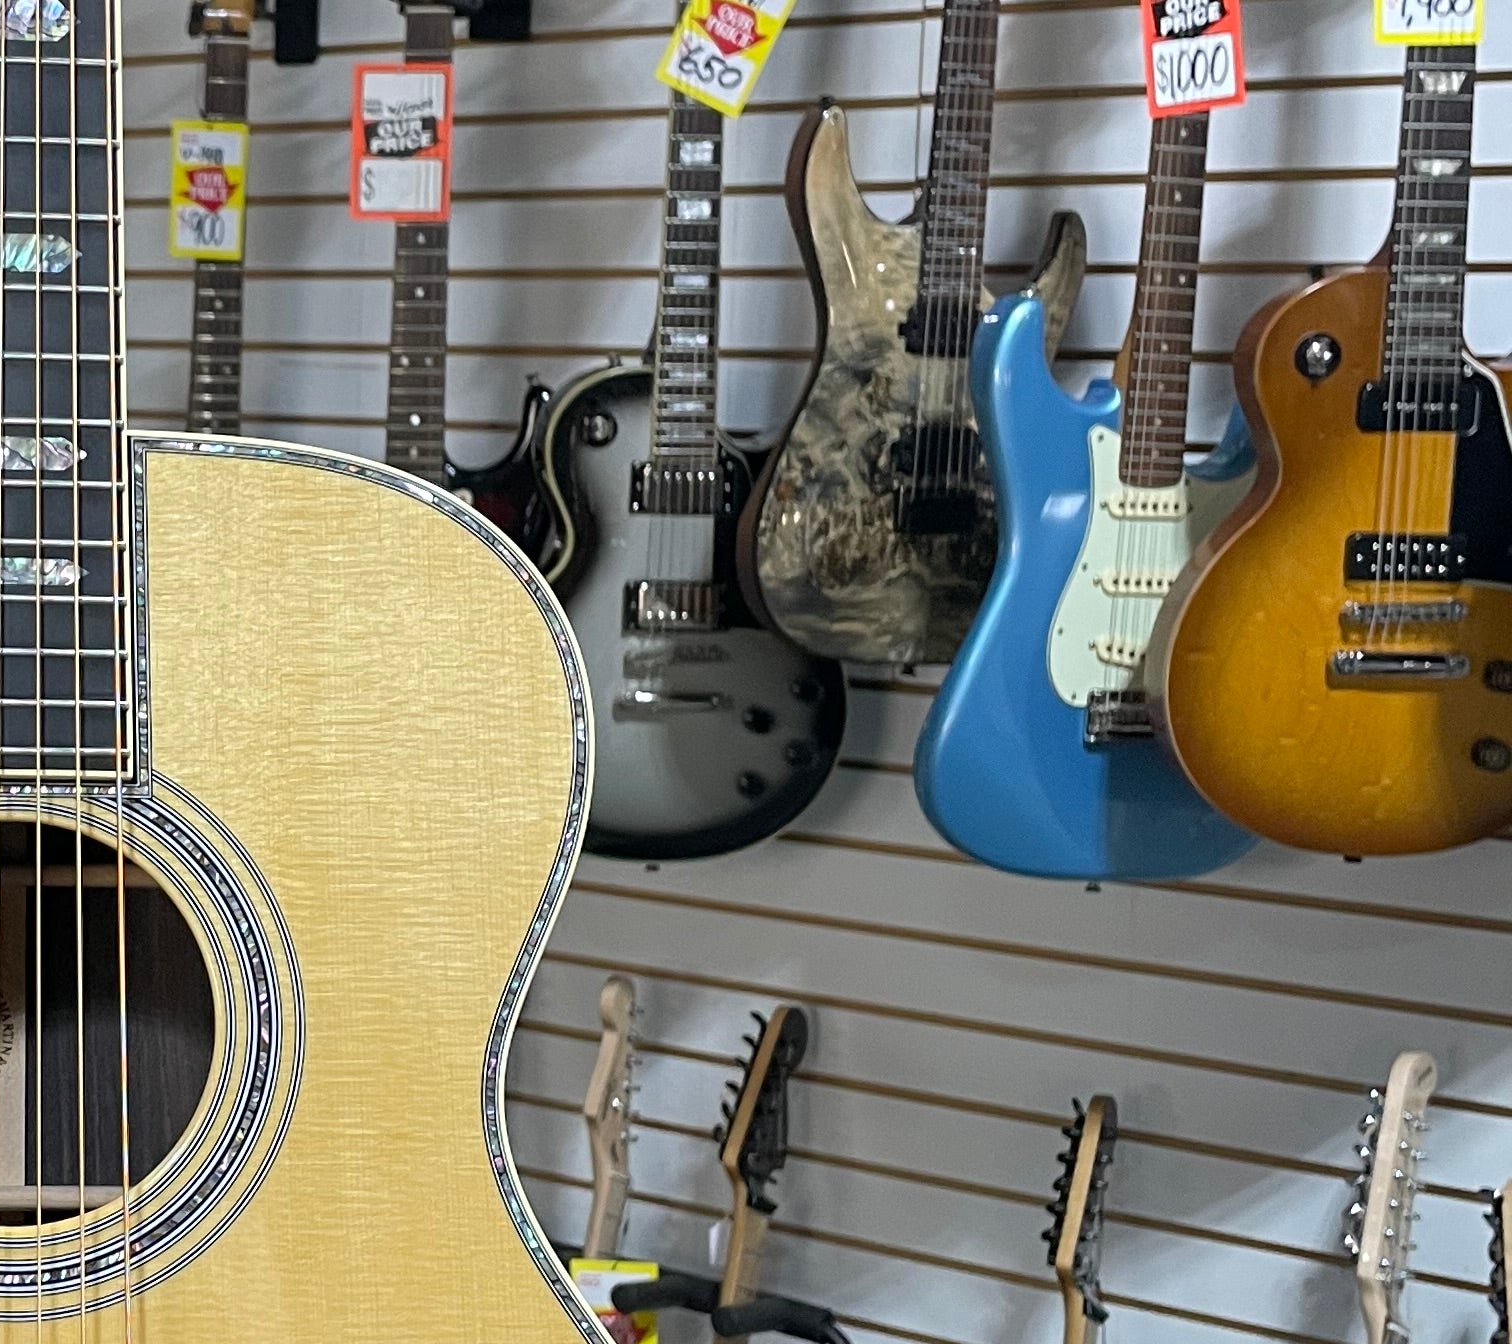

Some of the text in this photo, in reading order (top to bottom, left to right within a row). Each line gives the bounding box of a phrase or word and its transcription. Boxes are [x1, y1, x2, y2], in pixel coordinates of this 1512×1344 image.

[1159, 1, 1222, 37] PRICE
[1155, 41, 1230, 100] $1000
[369, 129, 436, 155] PRICE
[377, 120, 423, 139] OUR
